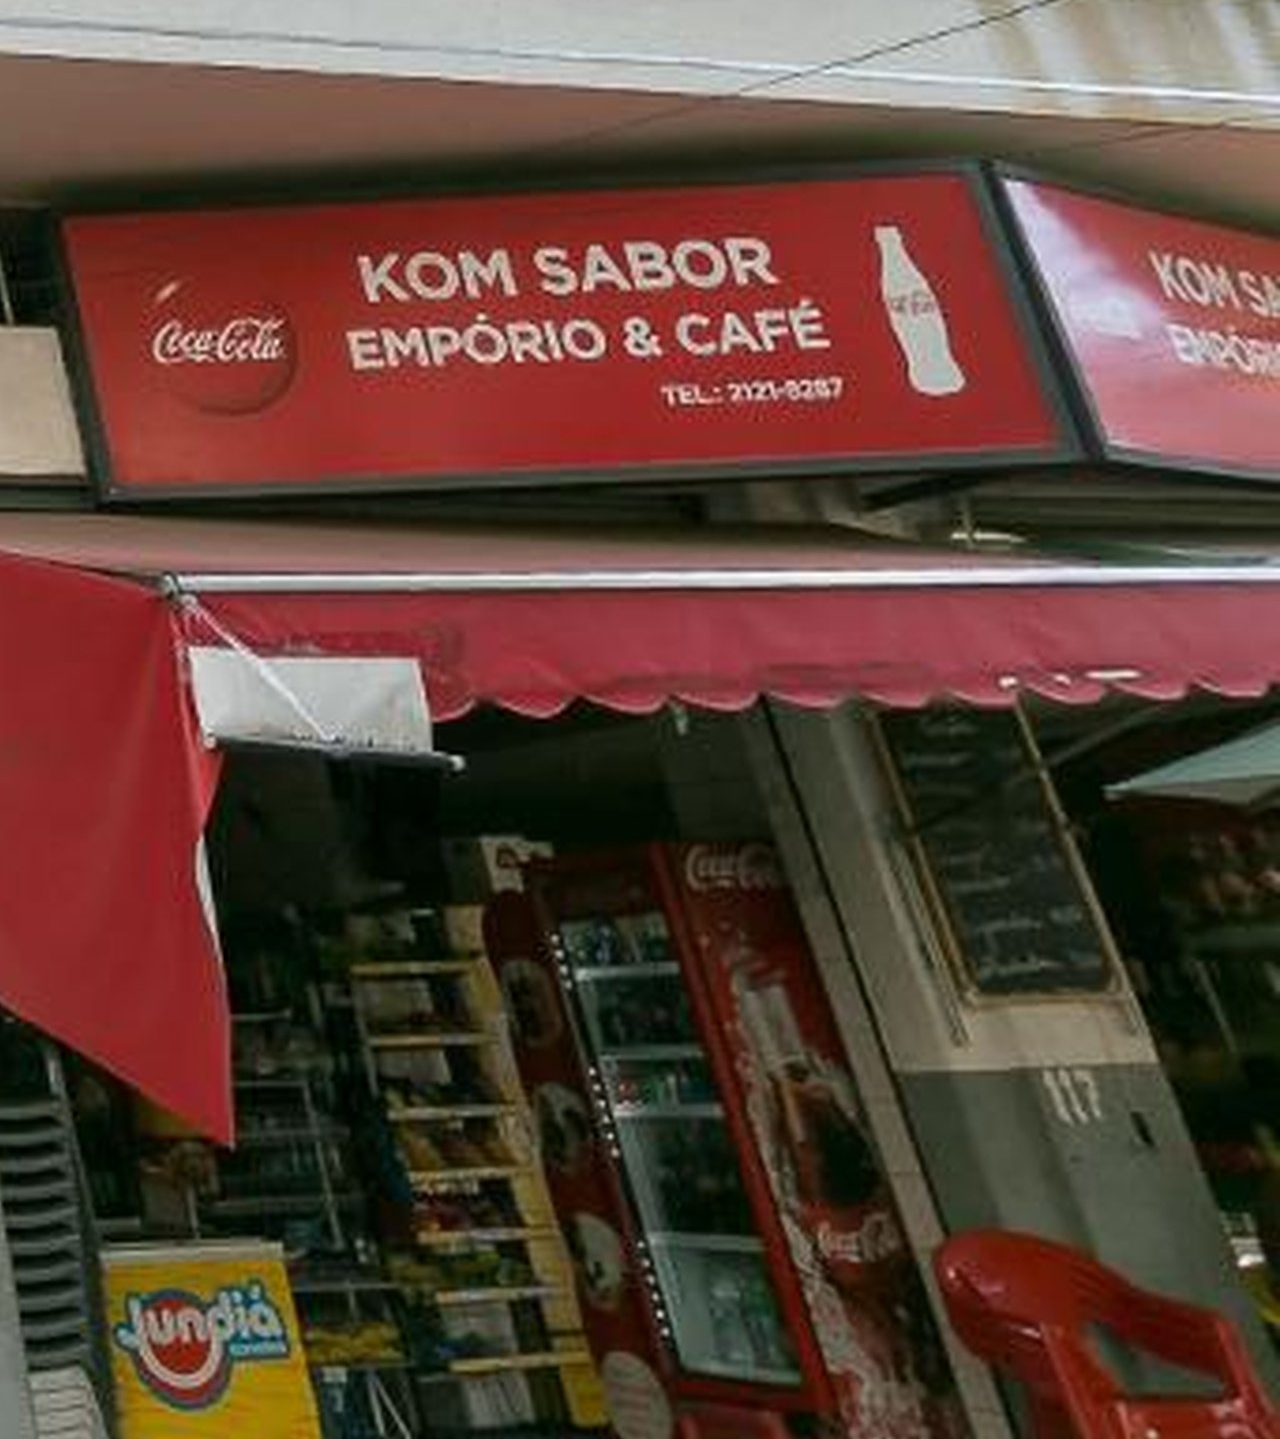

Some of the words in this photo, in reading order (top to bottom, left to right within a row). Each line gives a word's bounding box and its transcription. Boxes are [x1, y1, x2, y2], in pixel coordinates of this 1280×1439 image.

[356, 248, 519, 303] KOM
[533, 236, 781, 296] SABOR
[1148, 249, 1242, 309] KOM
[152, 317, 287, 364] Coca-Cola
[345, 312, 607, 371] EMPÓRIO
[622, 317, 663, 357] &
[675, 298, 831, 355] CAFÉ
[116, 1283, 284, 1352] Jundiá
